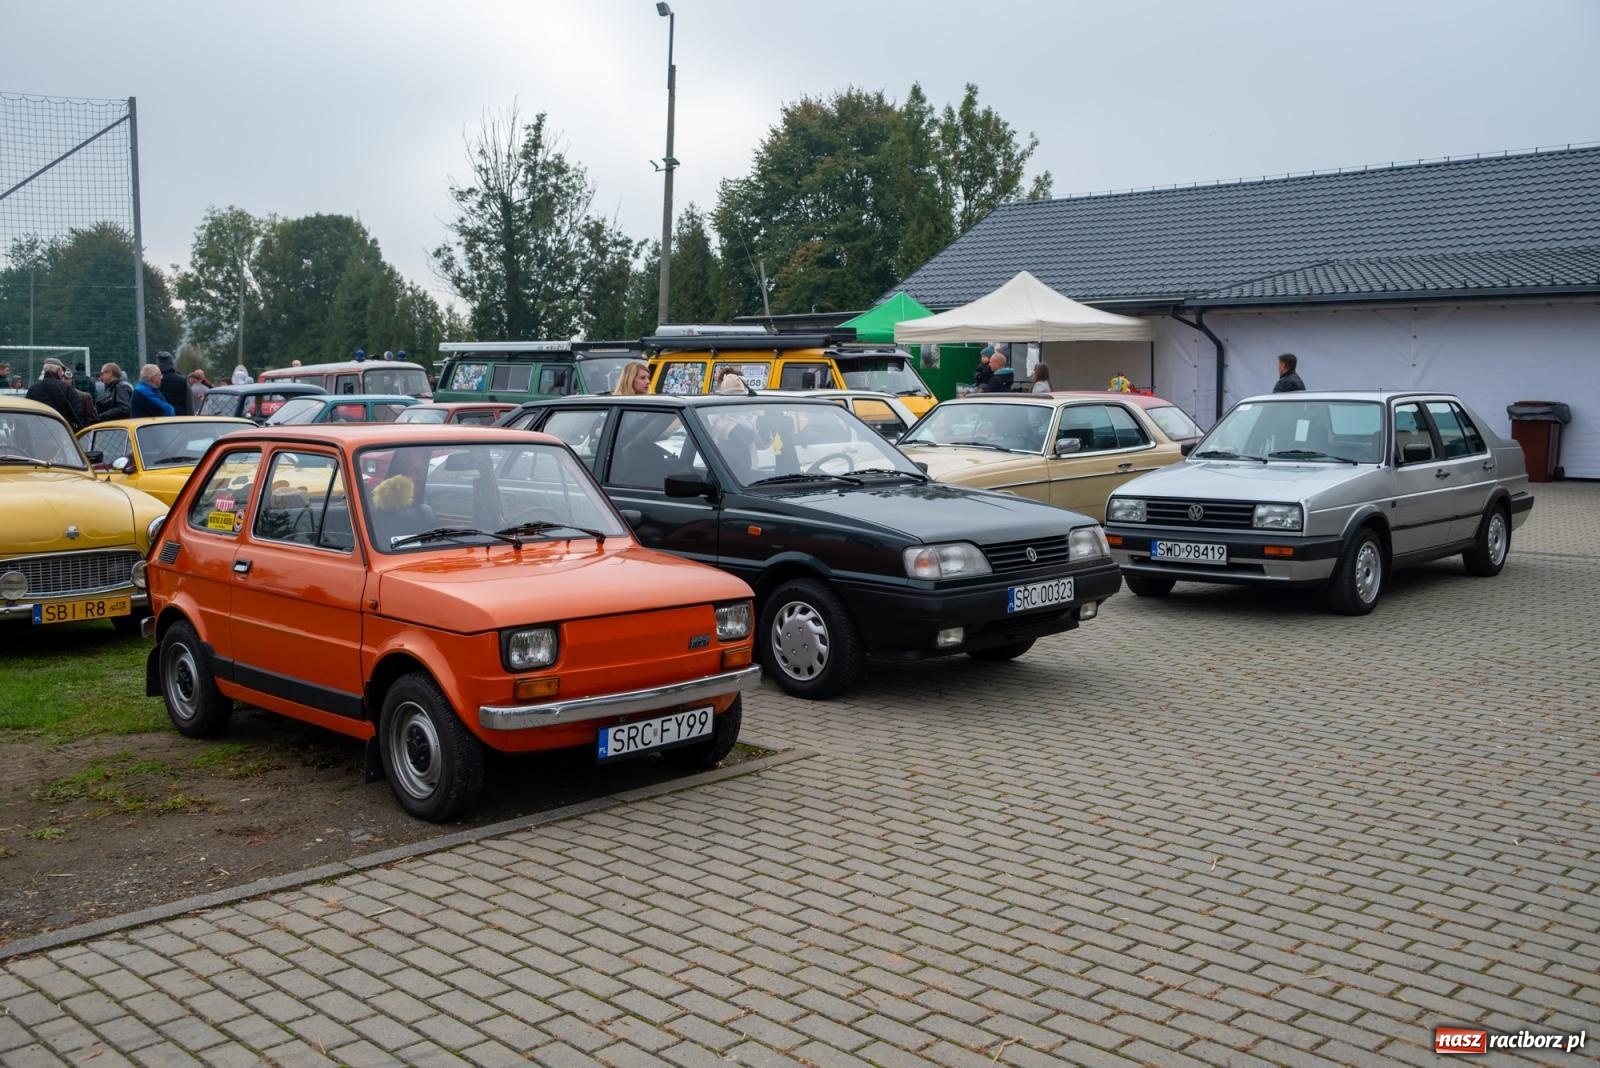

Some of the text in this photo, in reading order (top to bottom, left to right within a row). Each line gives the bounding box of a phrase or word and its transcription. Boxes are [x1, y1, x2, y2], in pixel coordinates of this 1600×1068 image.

[1158, 542, 1225, 560] SWD 98419
[1015, 580, 1073, 608] SRC 00323
[85, 600, 105, 617] R8
[612, 710, 709, 752] SRC FY99
